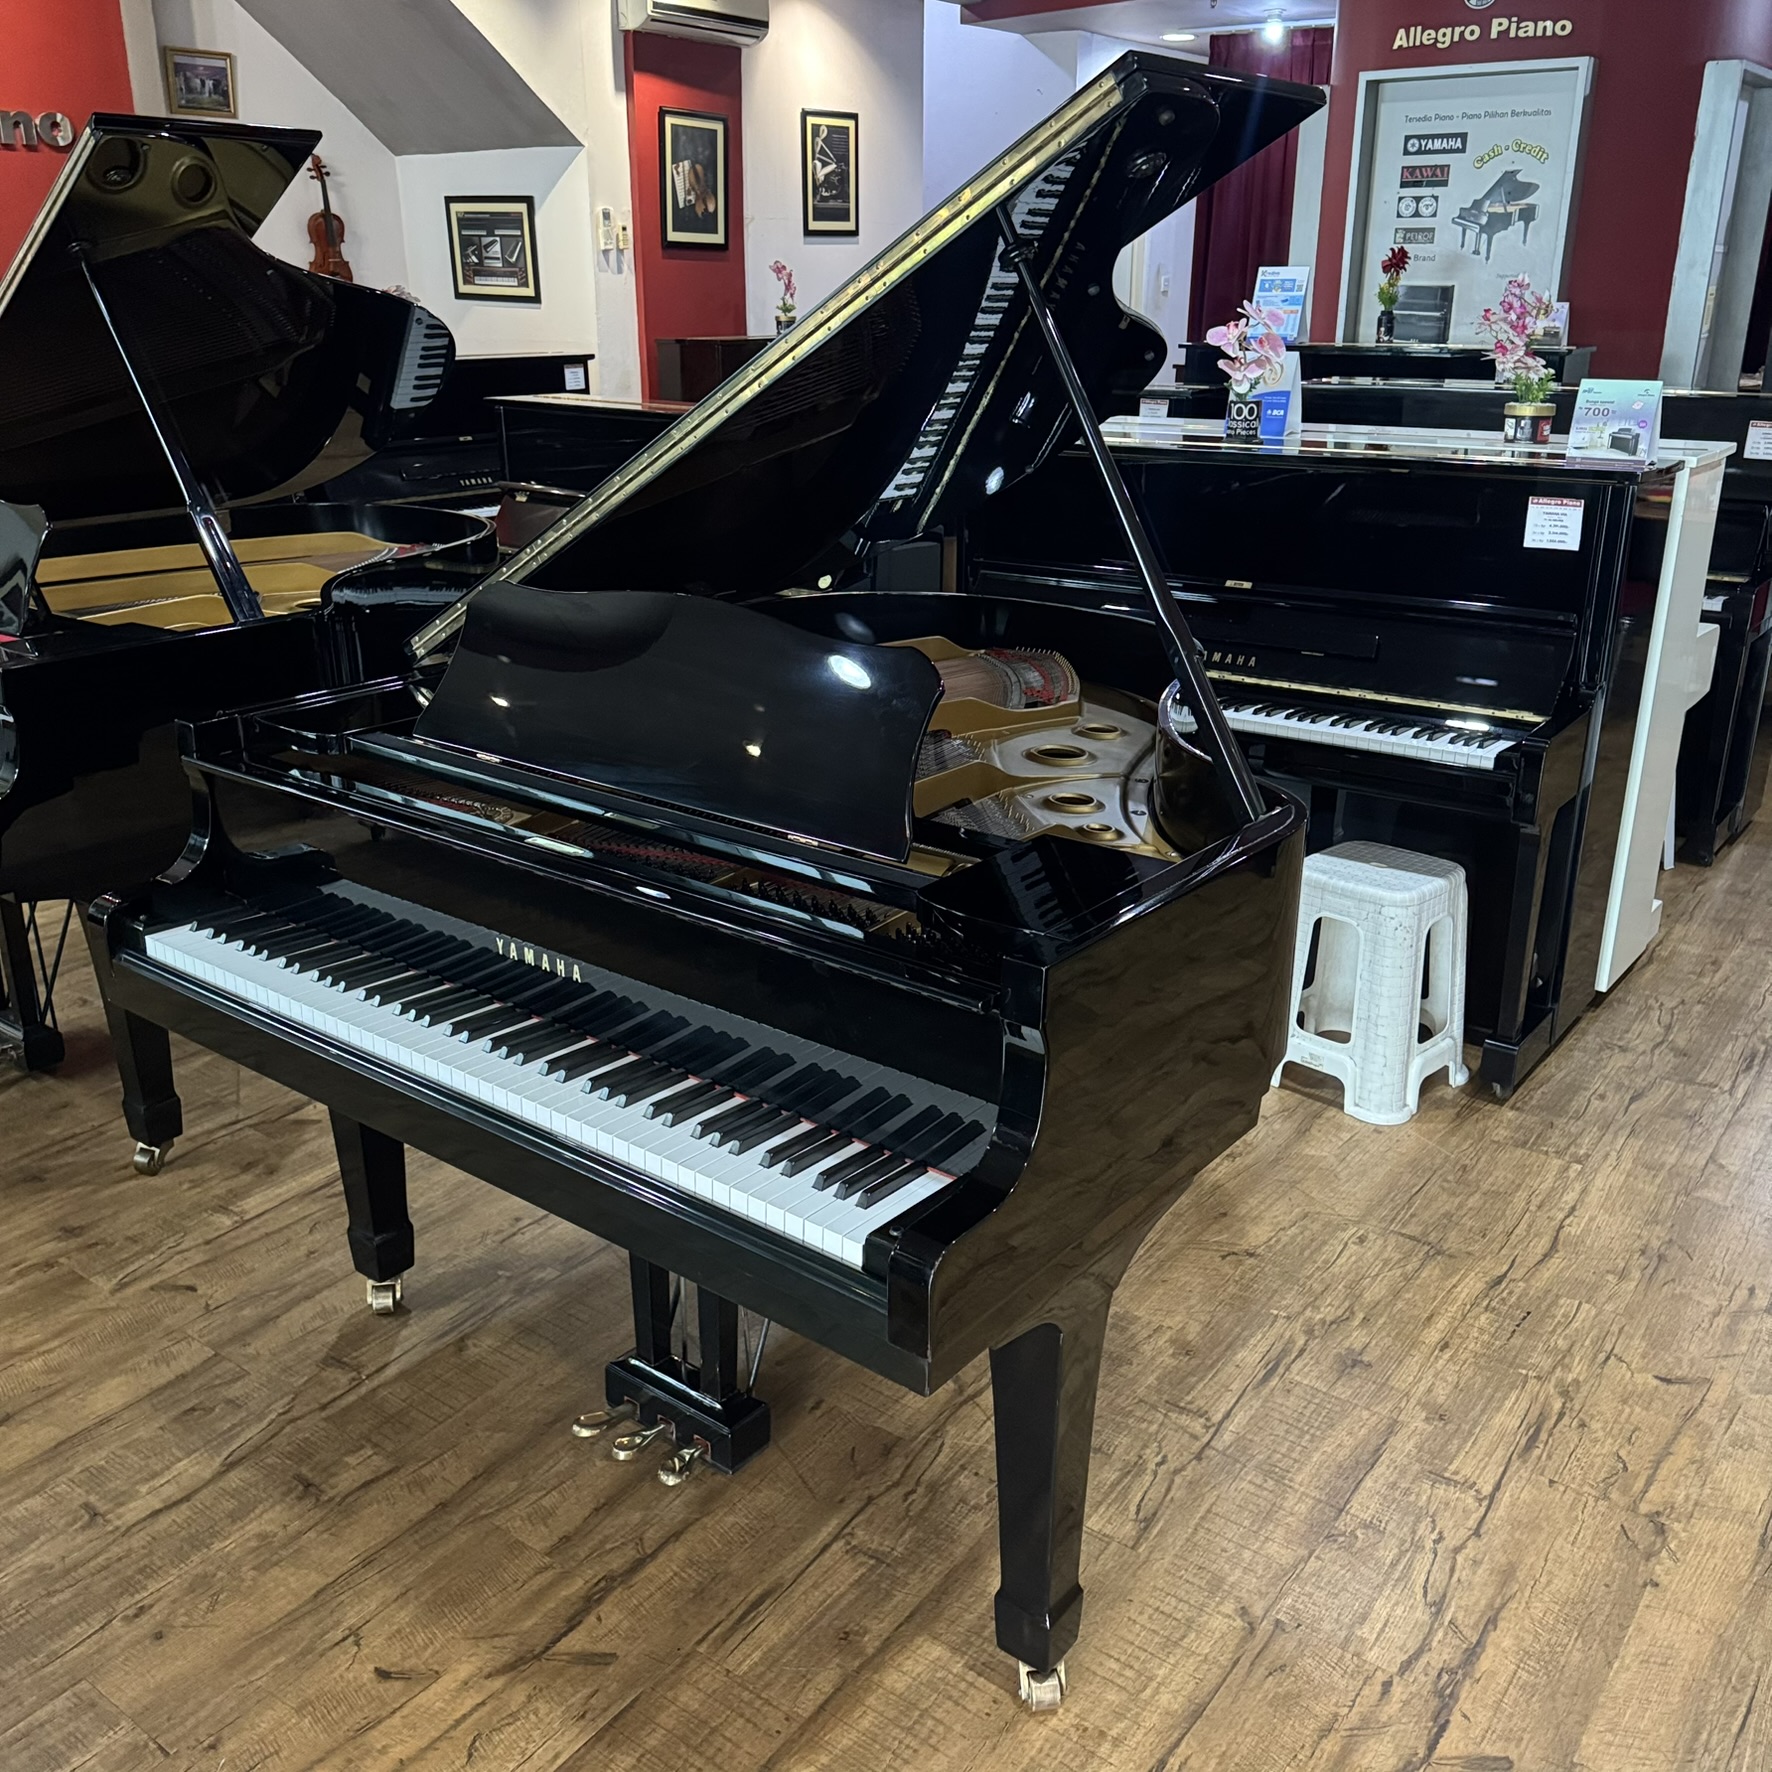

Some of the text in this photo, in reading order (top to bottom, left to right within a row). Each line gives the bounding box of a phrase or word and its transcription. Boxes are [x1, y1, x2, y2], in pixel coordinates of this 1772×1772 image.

[1392, 16, 1573, 50] Allegro Piano
[1434, 113, 1454, 121] Piano
[1461, 112, 1482, 120] Piano
[1484, 110, 1508, 119] Pilihan
[1510, 108, 1552, 118] Berkualitas
[1420, 137, 1462, 150] YAMAHA
[1473, 143, 1503, 169] Cash
[1511, 138, 1549, 164] Credit
[1402, 166, 1449, 179] KAWAI
[1413, 254, 1436, 262] Brand
[1230, 403, 1258, 420] 100
[1584, 407, 1611, 417] 700
[1236, 428, 1256, 436] Pieces
[1203, 651, 1256, 667] MAHA
[496, 937, 582, 983] YAMAHA
